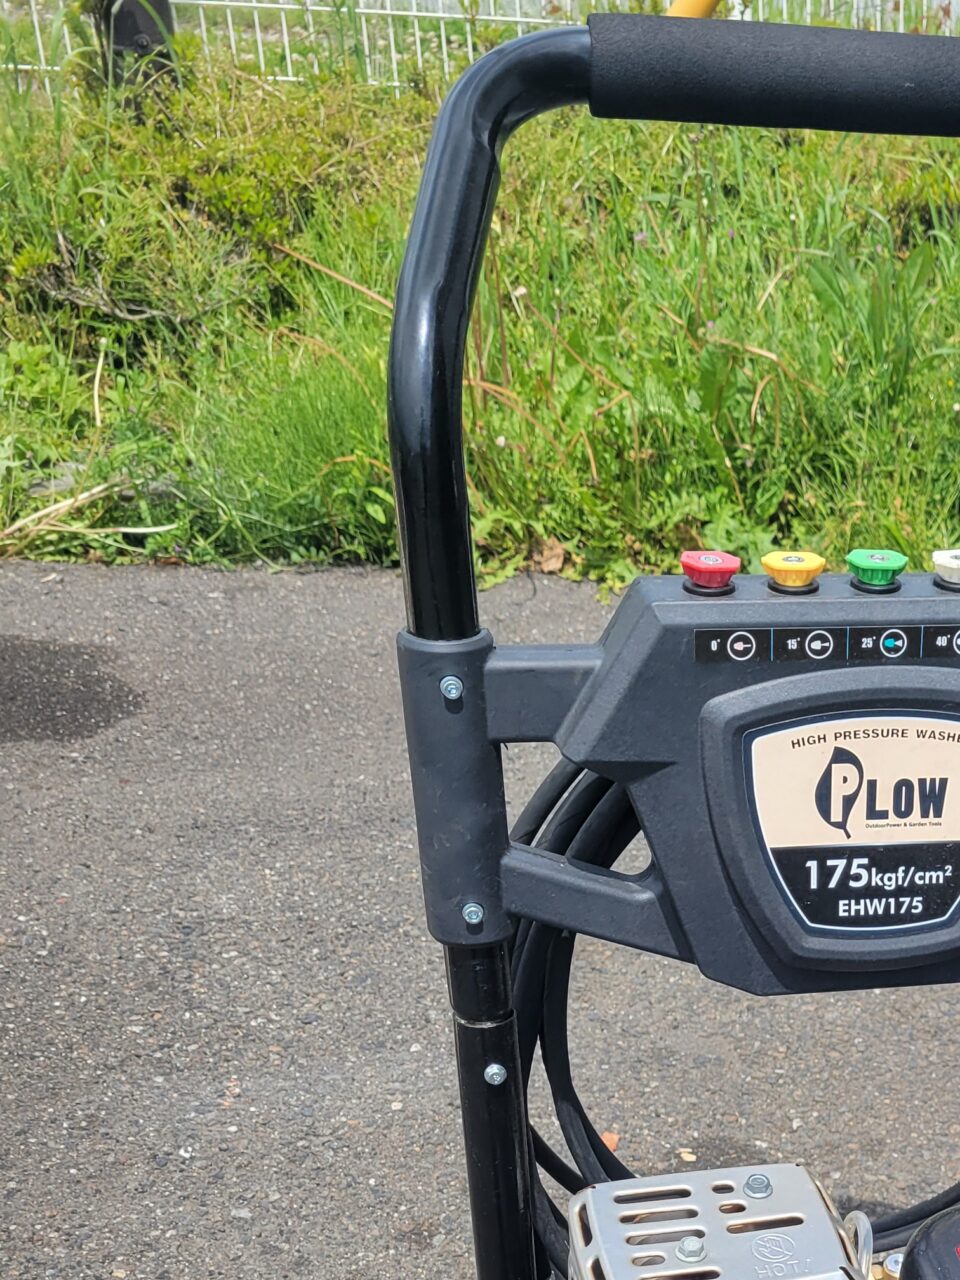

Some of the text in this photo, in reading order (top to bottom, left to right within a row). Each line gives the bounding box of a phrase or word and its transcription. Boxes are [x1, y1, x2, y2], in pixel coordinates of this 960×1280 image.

[790, 733, 827, 749] HIGH
[834, 728, 909, 742] PRESSURE
[830, 763, 949, 823] PLOW
[838, 896, 923, 917] EHW175
